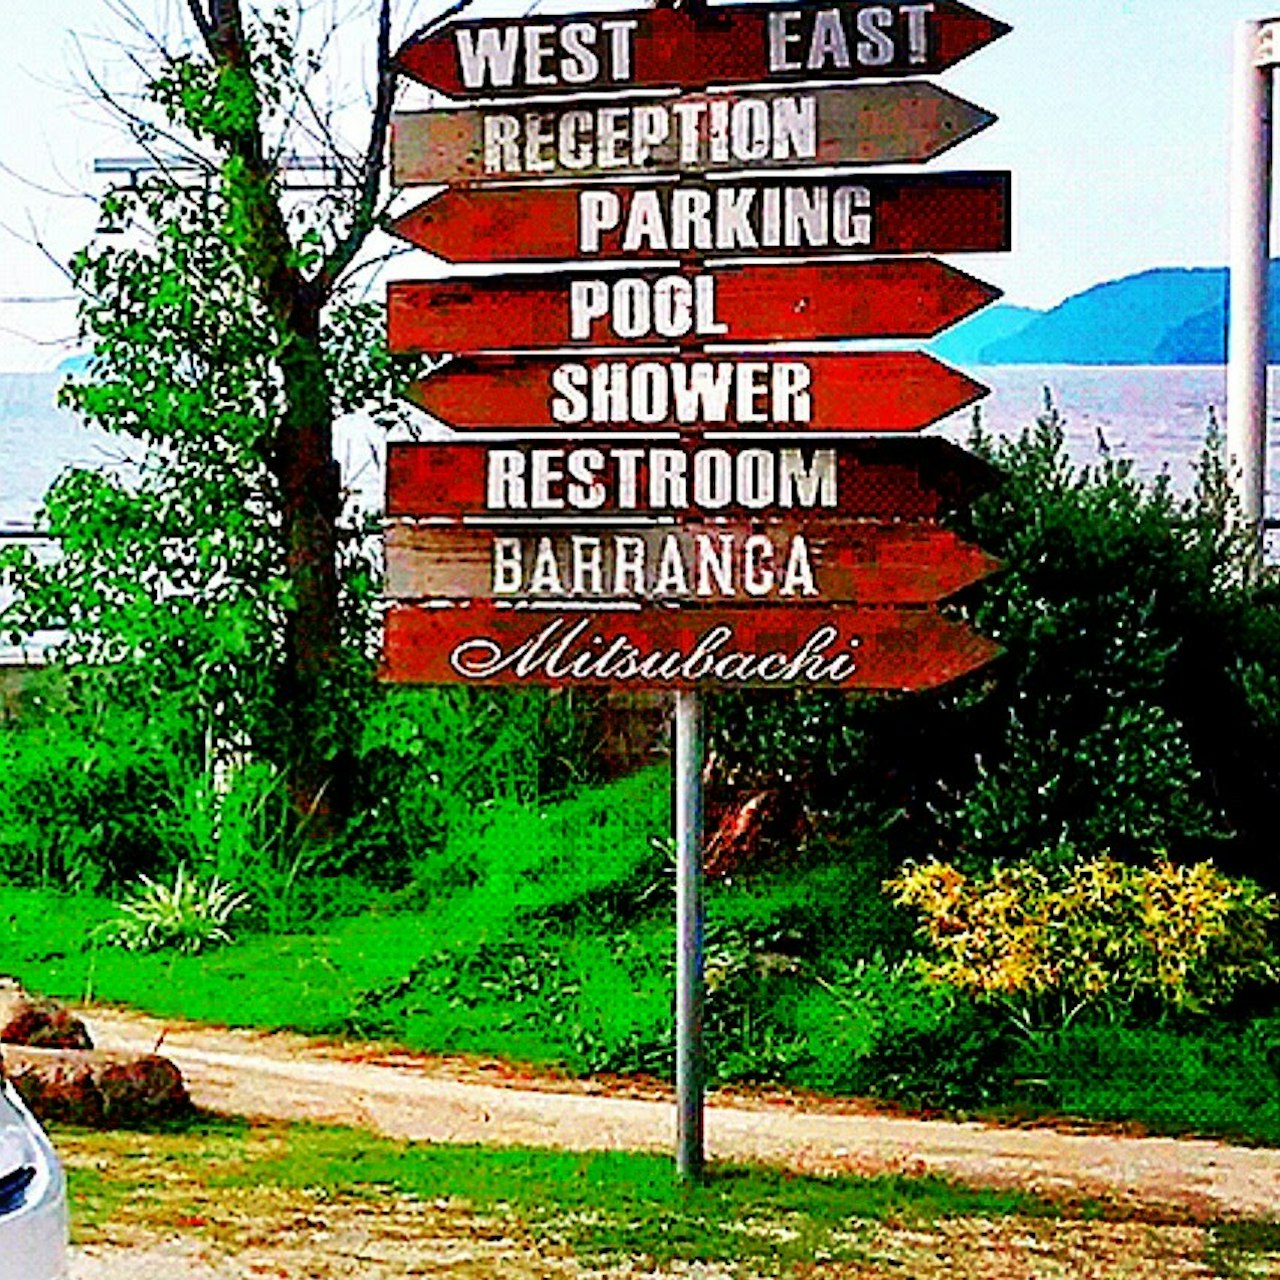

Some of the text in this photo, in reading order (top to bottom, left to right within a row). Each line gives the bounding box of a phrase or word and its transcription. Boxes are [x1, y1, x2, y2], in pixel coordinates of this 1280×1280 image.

[455, 2, 934, 88] WEST EAST
[484, 96, 817, 174] RECEPTION
[578, 185, 872, 252] PARKING
[571, 273, 727, 340] POOL
[551, 362, 811, 424] SHOWER
[487, 448, 837, 511] RESTROOM
[492, 533, 819, 598] BARRANCA
[450, 617, 856, 683] Mitsubachi
